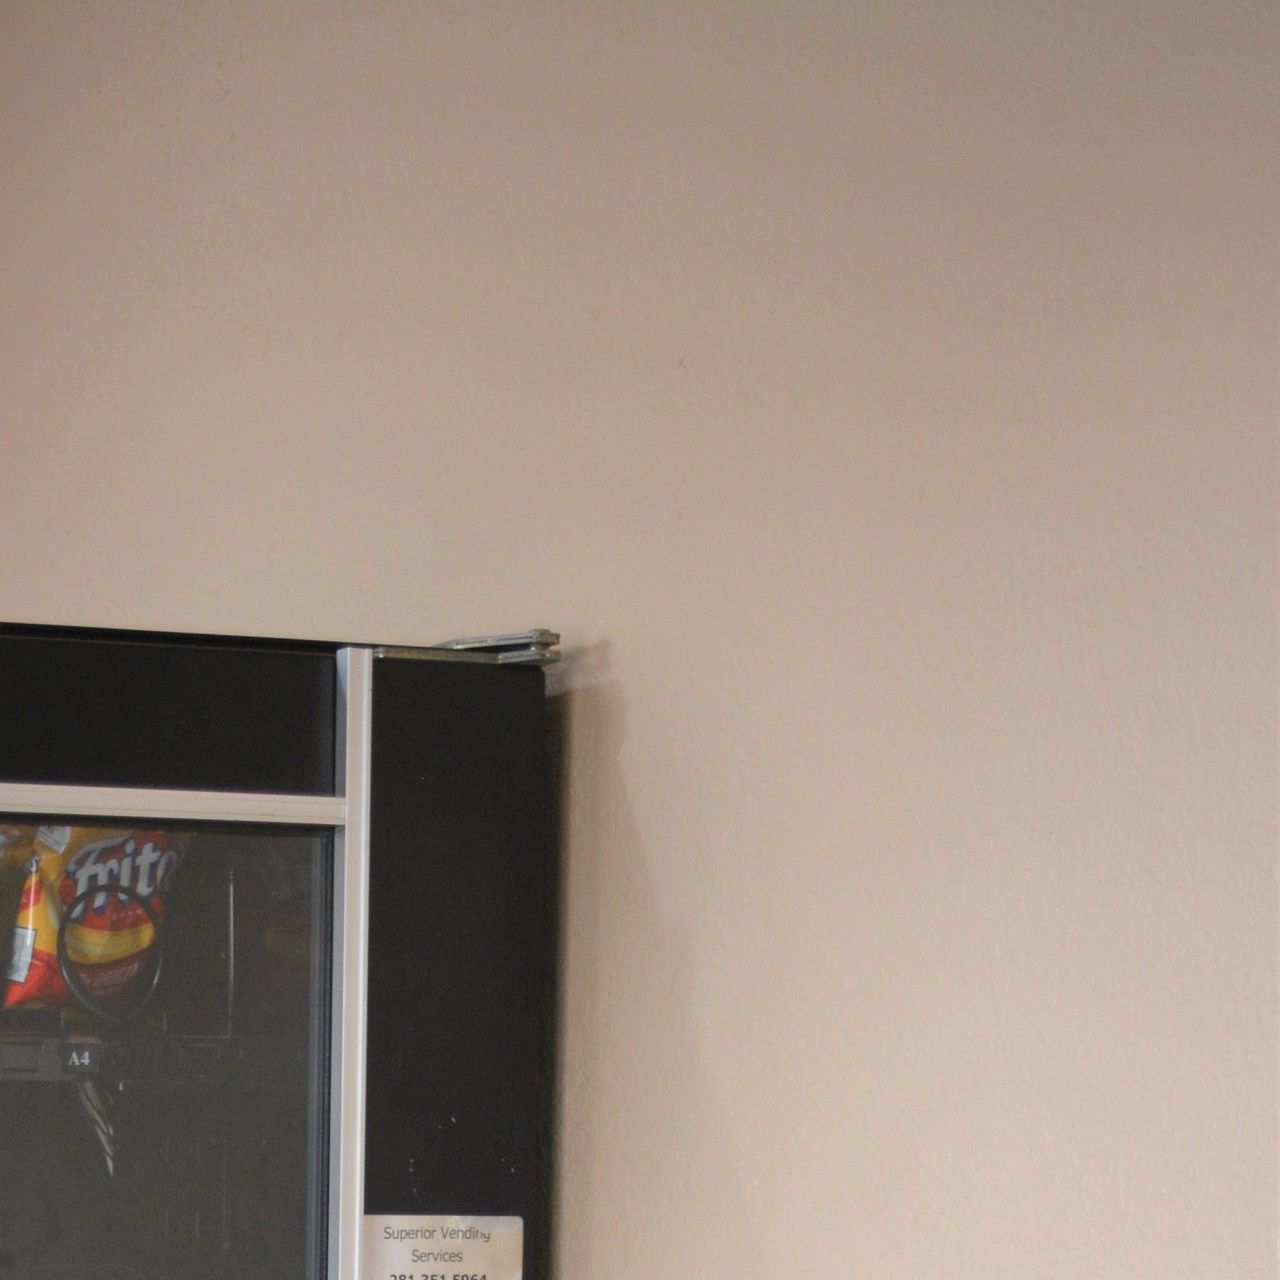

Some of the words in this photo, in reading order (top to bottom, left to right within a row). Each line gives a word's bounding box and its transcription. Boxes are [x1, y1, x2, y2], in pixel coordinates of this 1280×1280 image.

[68, 1051, 90, 1066] A4
[384, 1226, 435, 1242] Superior
[411, 1249, 463, 1262] Services
